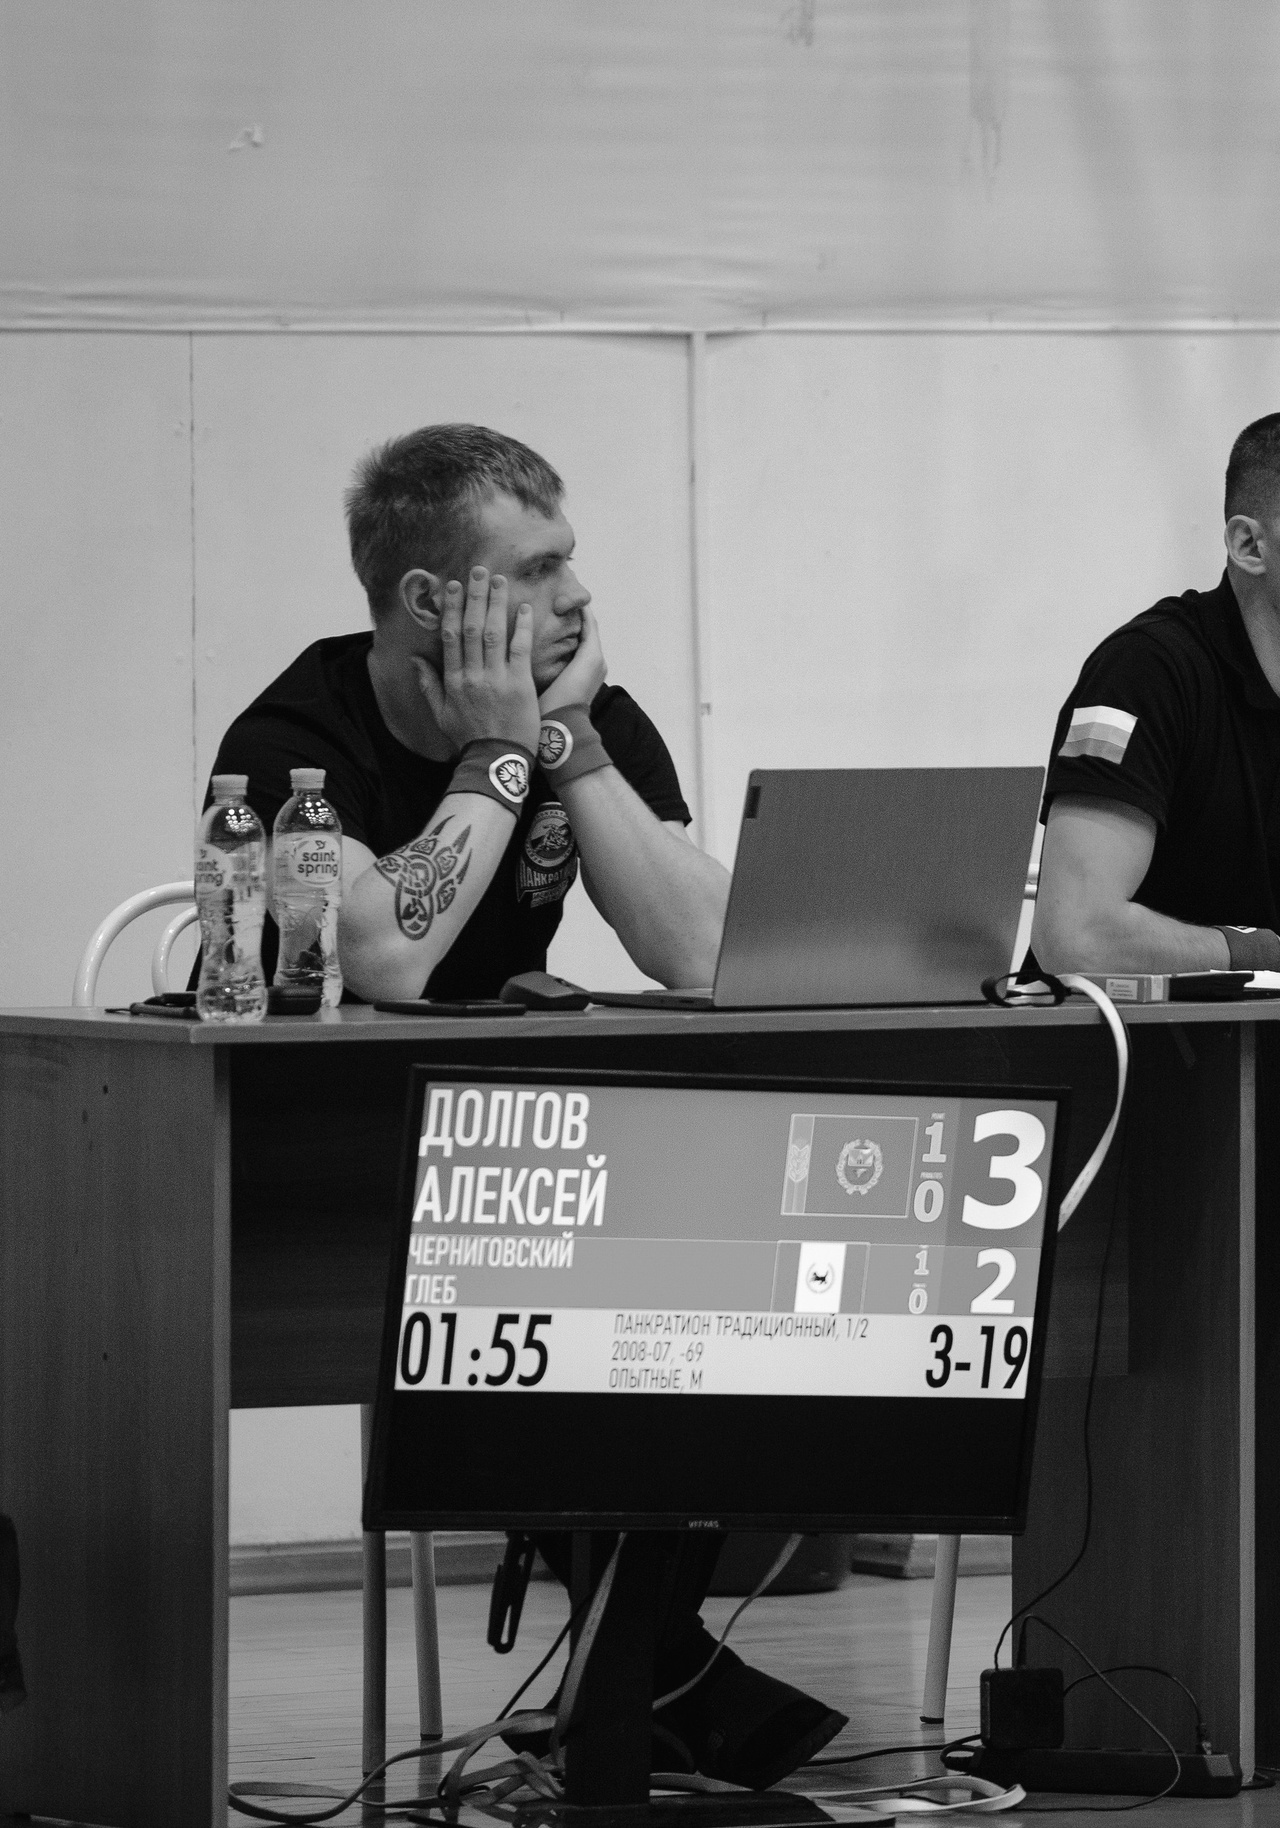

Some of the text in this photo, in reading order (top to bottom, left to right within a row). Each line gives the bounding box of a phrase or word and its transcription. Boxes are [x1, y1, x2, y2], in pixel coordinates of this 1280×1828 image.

[297, 863, 338, 877] spring
[302, 850, 336, 863] saint
[195, 871, 224, 887] ring
[418, 1089, 590, 1158] ДОЛГОВ
[922, 1121, 947, 1163] 1
[961, 1109, 1046, 1230] 3
[412, 1154, 608, 1226] АЛЕКСЕЙ
[913, 1180, 945, 1223] 0
[409, 1231, 575, 1268] ЧЕРНИГОВСКИЙ
[914, 1250, 930, 1276] 1
[404, 1274, 457, 1304] ГЛЕБ
[970, 1248, 1017, 1314] 2
[908, 1288, 928, 1315] 0
[614, 1313, 869, 1341] ПАНКРАТИОН ТРАДИЦИОННЫЙ, 1/2
[400, 1311, 553, 1387] 01:55
[611, 1341, 704, 1364] 2008-07, -69
[924, 1324, 1029, 1390] 3-19
[608, 1367, 703, 1392] ОПЫТНЫЕ, М
